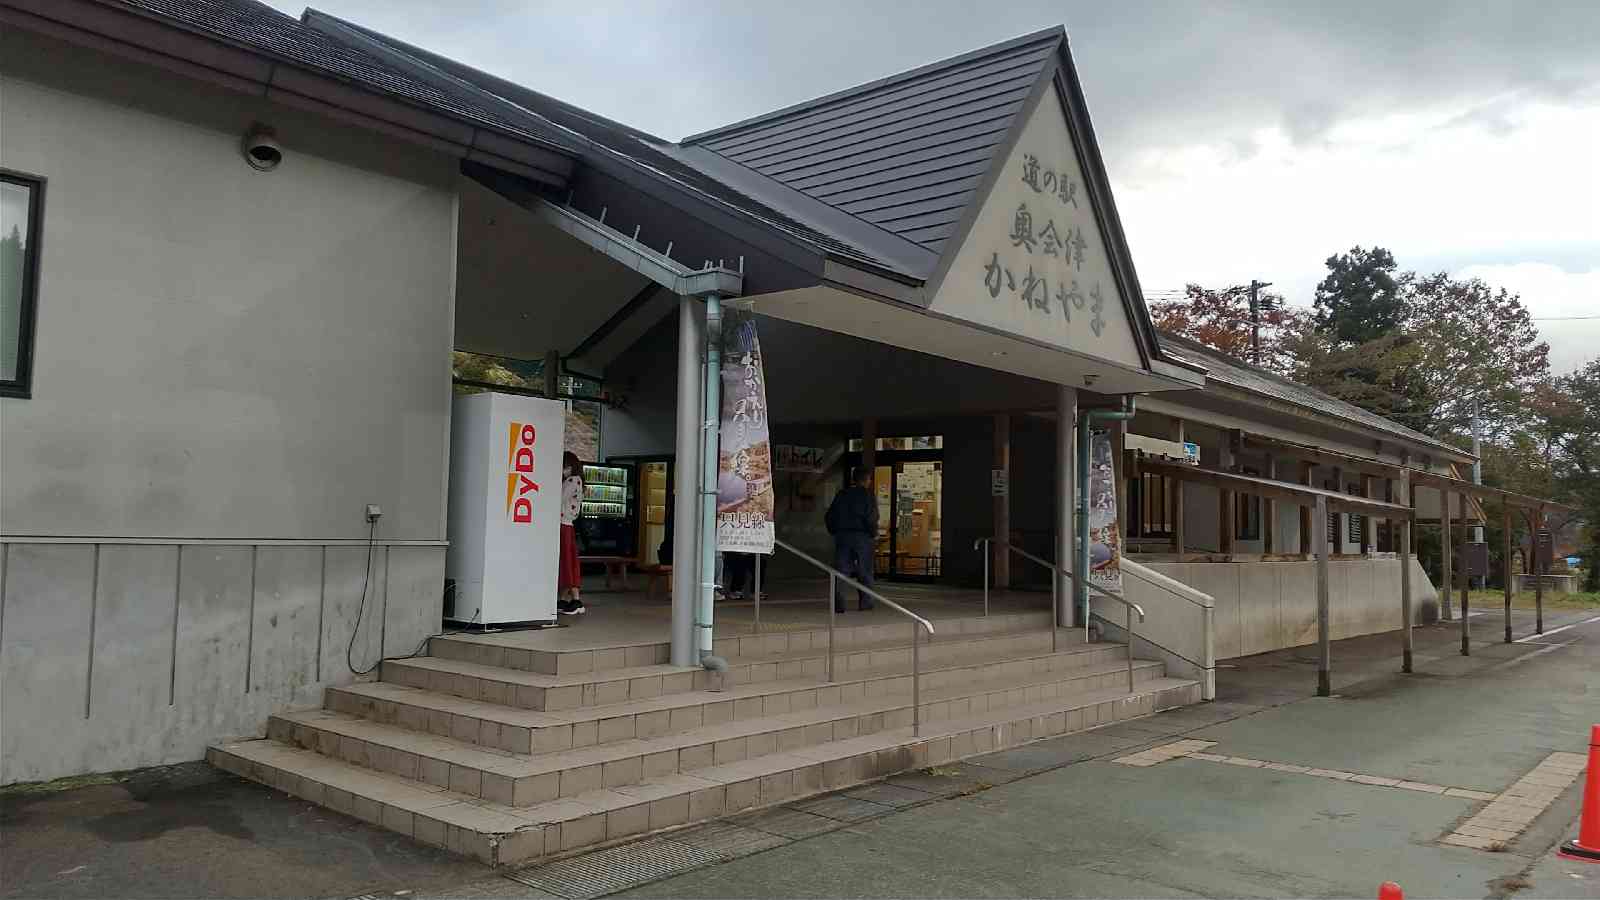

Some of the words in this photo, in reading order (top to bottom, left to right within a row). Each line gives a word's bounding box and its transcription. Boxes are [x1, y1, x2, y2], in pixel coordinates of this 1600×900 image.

[1022, 153, 1078, 209] 道の駅
[1009, 203, 1088, 272] 奥会津
[984, 252, 1106, 338] かねやま
